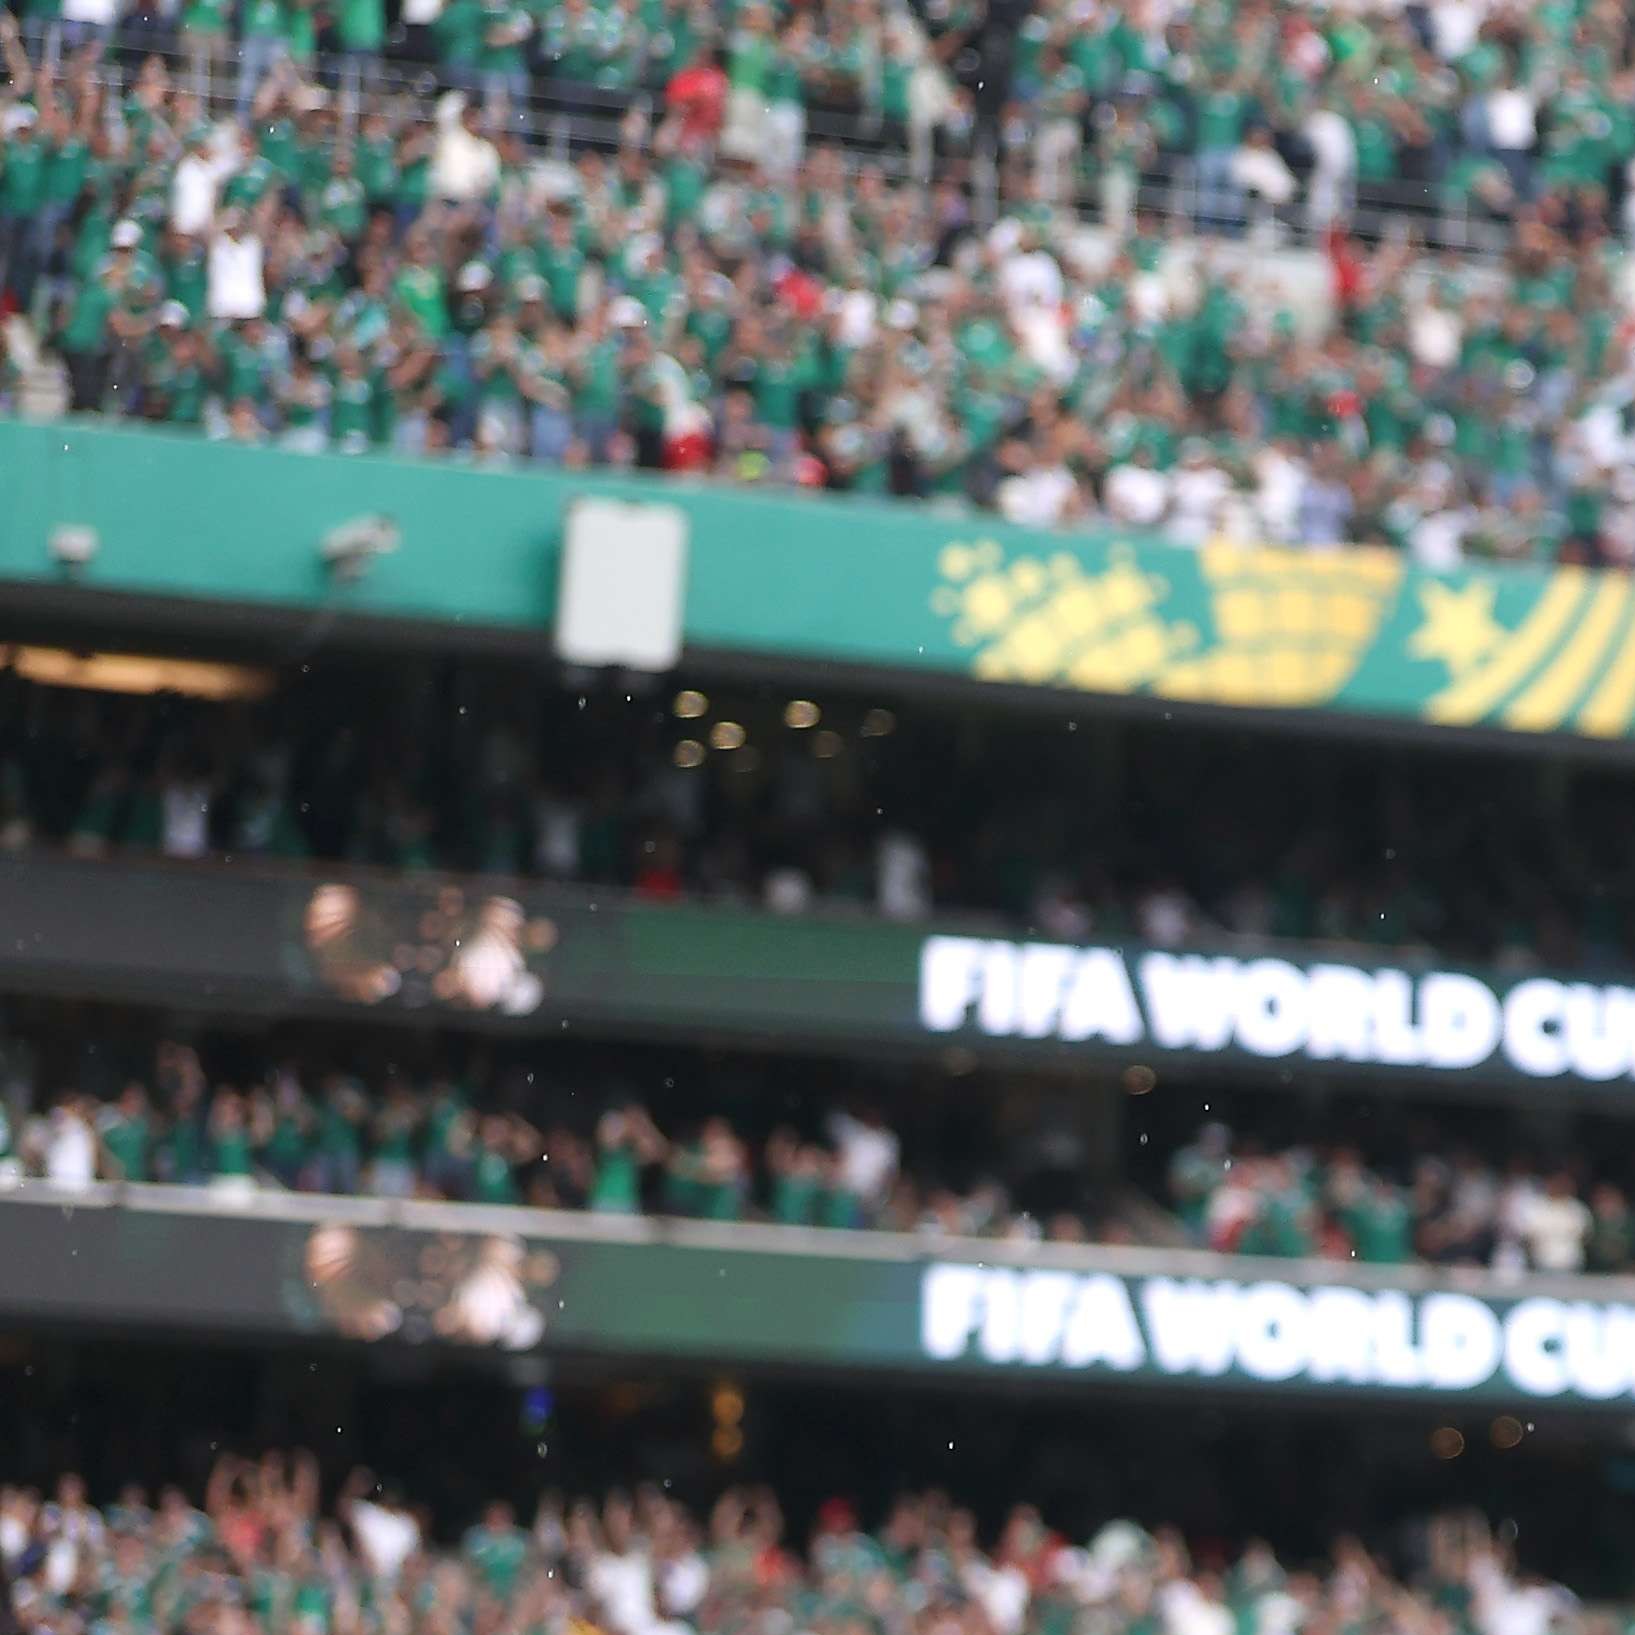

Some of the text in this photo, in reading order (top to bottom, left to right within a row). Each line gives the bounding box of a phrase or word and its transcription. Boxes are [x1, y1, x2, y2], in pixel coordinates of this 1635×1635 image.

[920, 934, 1143, 1047] FIFA
[1137, 952, 1501, 1070] WORLD
[920, 1262, 1144, 1371] FIFA
[1138, 1277, 1501, 1390] WORLD
